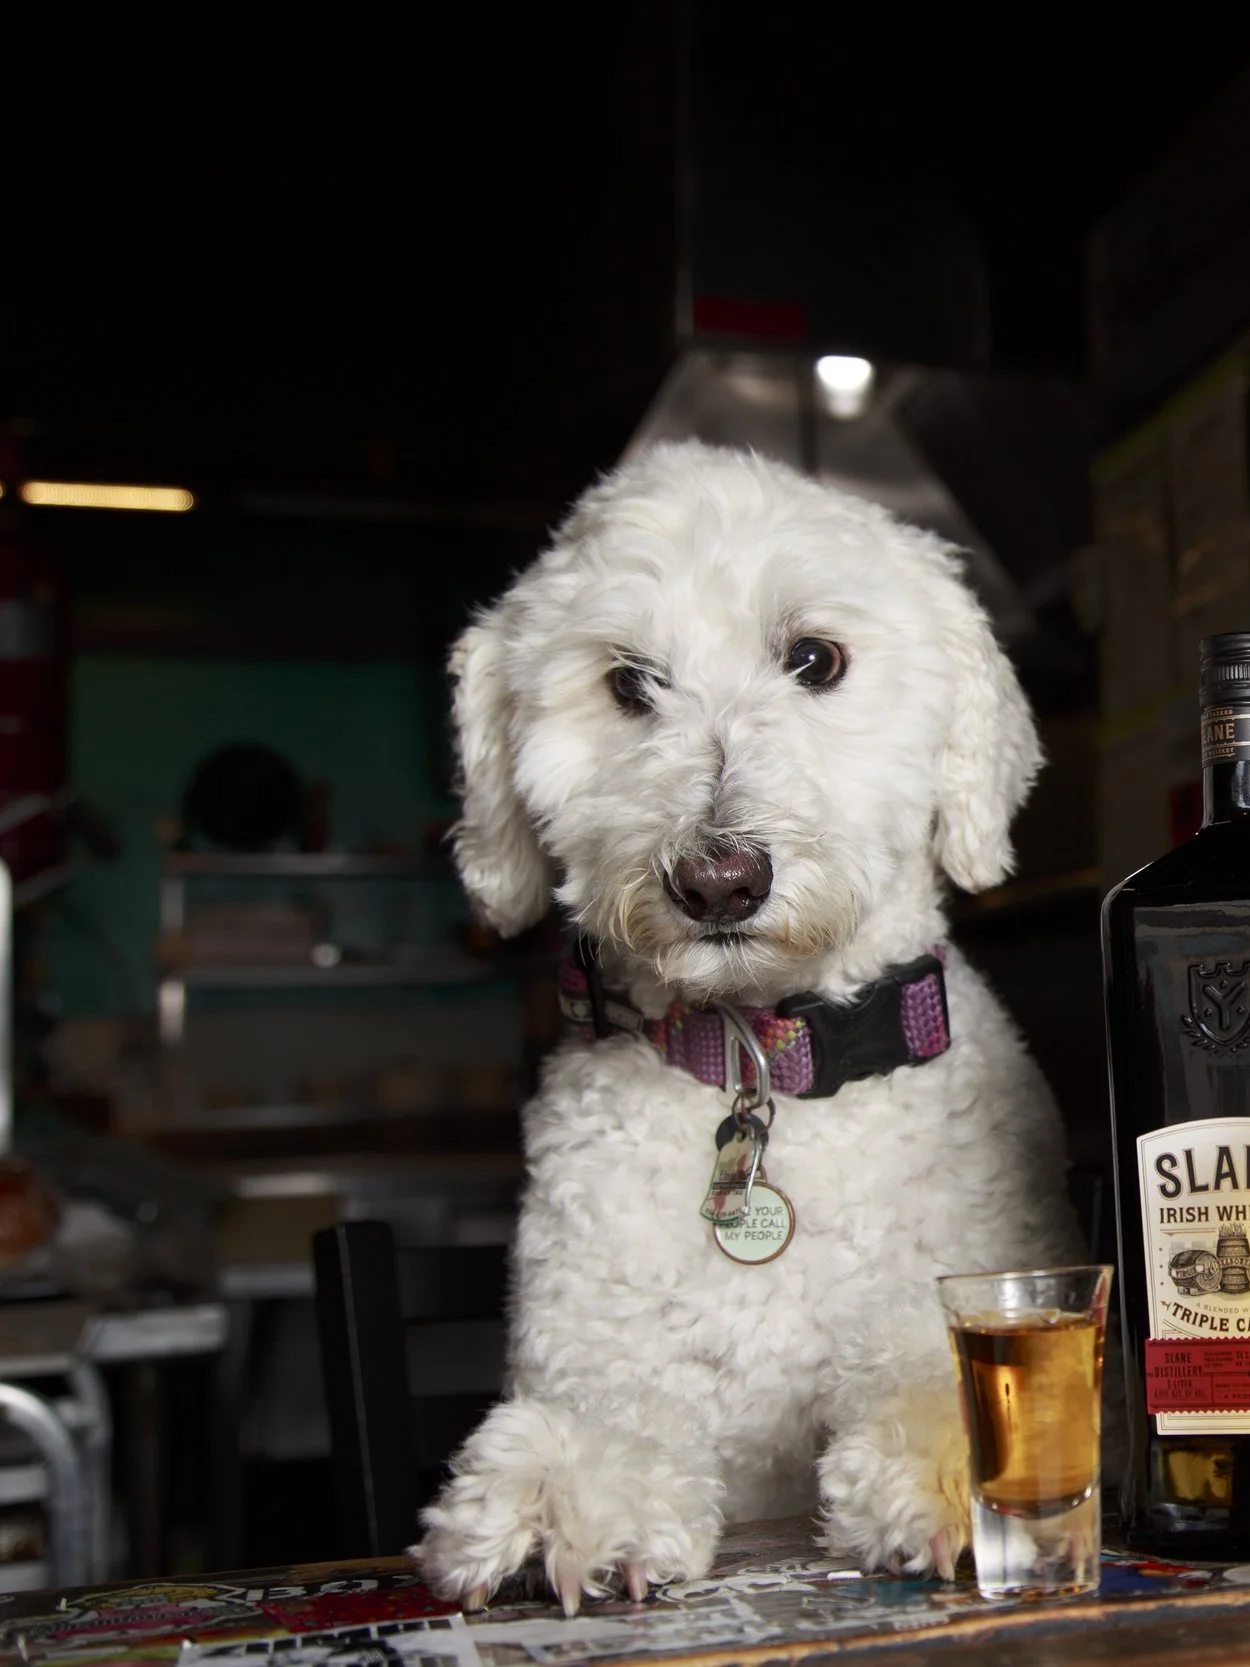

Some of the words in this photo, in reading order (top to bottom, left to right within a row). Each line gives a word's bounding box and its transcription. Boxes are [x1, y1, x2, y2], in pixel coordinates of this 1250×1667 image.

[755, 1206, 783, 1216] YOUR
[1159, 1206, 1209, 1224] IRISH
[760, 1218, 785, 1229] CALL
[724, 1231, 741, 1241] MY
[744, 1231, 783, 1241] PEOPLE
[1203, 1305, 1239, 1314] BLENDED
[1172, 1302, 1230, 1333] TRIPLE
[1164, 1352, 1192, 1364] SLANE
[1154, 1366, 1203, 1378] DISTILLERY
